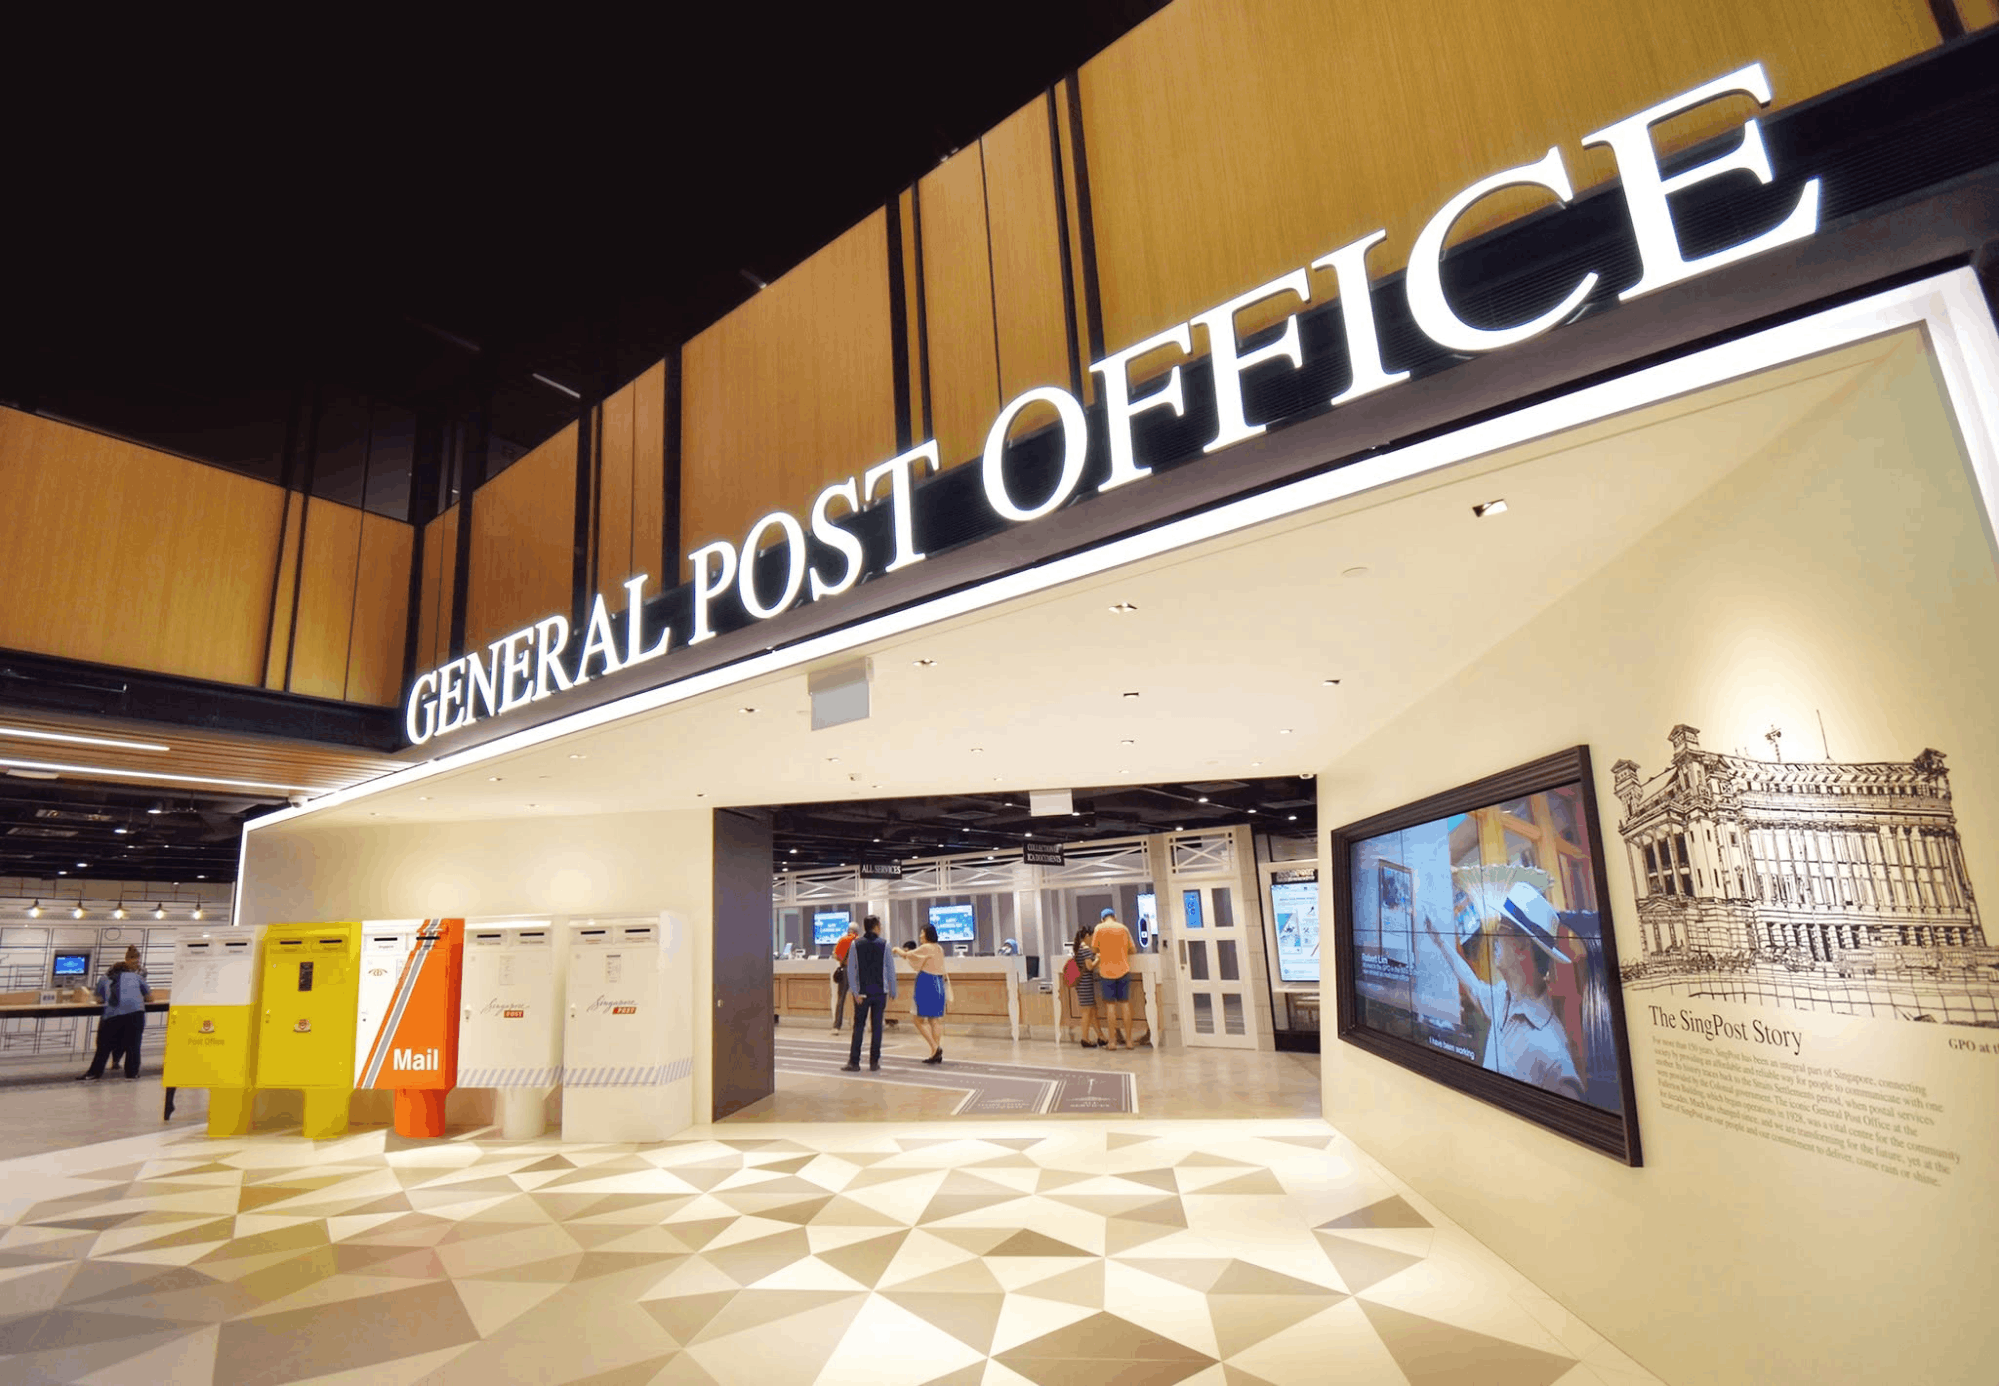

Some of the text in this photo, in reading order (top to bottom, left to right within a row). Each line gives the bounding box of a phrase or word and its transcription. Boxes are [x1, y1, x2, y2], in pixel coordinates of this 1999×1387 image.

[405, 63, 1820, 745] GENERAL POST OFFICE
[861, 864, 901, 874] ALL SERVICES
[505, 1010, 523, 1018] POST
[587, 994, 639, 1014] Singapore
[1648, 1005, 1802, 1056] The SingPost Story
[1948, 1038, 1976, 1051] GPO
[1979, 1044, 1990, 1053] at
[393, 1048, 439, 1071] Mail
[1455, 1046, 1475, 1061] working
[1743, 1066, 1754, 1075] and
[1756, 1069, 1779, 1080] reliable
[1782, 1075, 1794, 1086] way
[1796, 1075, 1806, 1085] for
[1808, 1079, 1833, 1092] people
[1835, 1084, 1843, 1093] to
[1845, 1087, 1901, 1105] communicate
[1902, 1097, 1924, 1109] with
[1925, 1102, 1944, 1113] one
[1753, 1055, 1769, 1066] been
[1780, 1062, 1806, 1074] integral
[1807, 1067, 1822, 1076] part
[1823, 1068, 1832, 1078] of
[1833, 1068, 1876, 1086] Singapore,
[1878, 1079, 1927, 1098] connecting
[1742, 1077, 1751, 1086] the
[1774, 1083, 1815, 1100] Settlements
[1816, 1094, 1843, 1107] period,
[1845, 1098, 1868, 1111] when
[1869, 1105, 1894, 1118] postal
[1897, 1111, 1935, 1126] services
[1774, 1095, 1787, 1107] The
[1789, 1099, 1811, 1112] iconic
[1812, 1104, 1843, 1119] General
[1844, 1110, 1862, 1124] Post
[1862, 1115, 1891, 1131] Office
[1893, 1124, 1901, 1133] at
[1903, 1125, 1918, 1138] the
[1717, 1107, 1740, 1119] changed
[1761, 1119, 1773, 1128] and
[1774, 1122, 1783, 1131] we
[1785, 1126, 1796, 1134] are
[1797, 1127, 1845, 1149] transforming
[1846, 1139, 1858, 1150] for
[1860, 1142, 1874, 1155] the
[1875, 1145, 1905, 1164] future,
[1908, 1156, 1921, 1167] yet
[1924, 1160, 1933, 1170] at
[1935, 1161, 1951, 1175] the
[1724, 1096, 1742, 1108] began
[1743, 1103, 1776, 1116] operations
[1807, 1118, 1821, 1127] was
[1823, 1122, 1828, 1130] a
[1829, 1121, 1847, 1134] vital
[1848, 1128, 1874, 1140] centre
[1875, 1132, 1888, 1144] for
[1890, 1136, 1905, 1148] the
[1906, 1142, 1960, 1165] community
[1725, 1121, 1745, 1132] people
[1746, 1127, 1758, 1136] and
[1758, 1131, 1770, 1139] our
[1771, 1134, 1815, 1153] commitment
[1816, 1145, 1824, 1155] to
[1826, 1147, 1854, 1164] deliver,
[1856, 1157, 1879, 1171] come
[1881, 1164, 1899, 1176] rain
[1900, 1169, 1910, 1179] or
[1913, 1170, 1942, 1187] shine.
